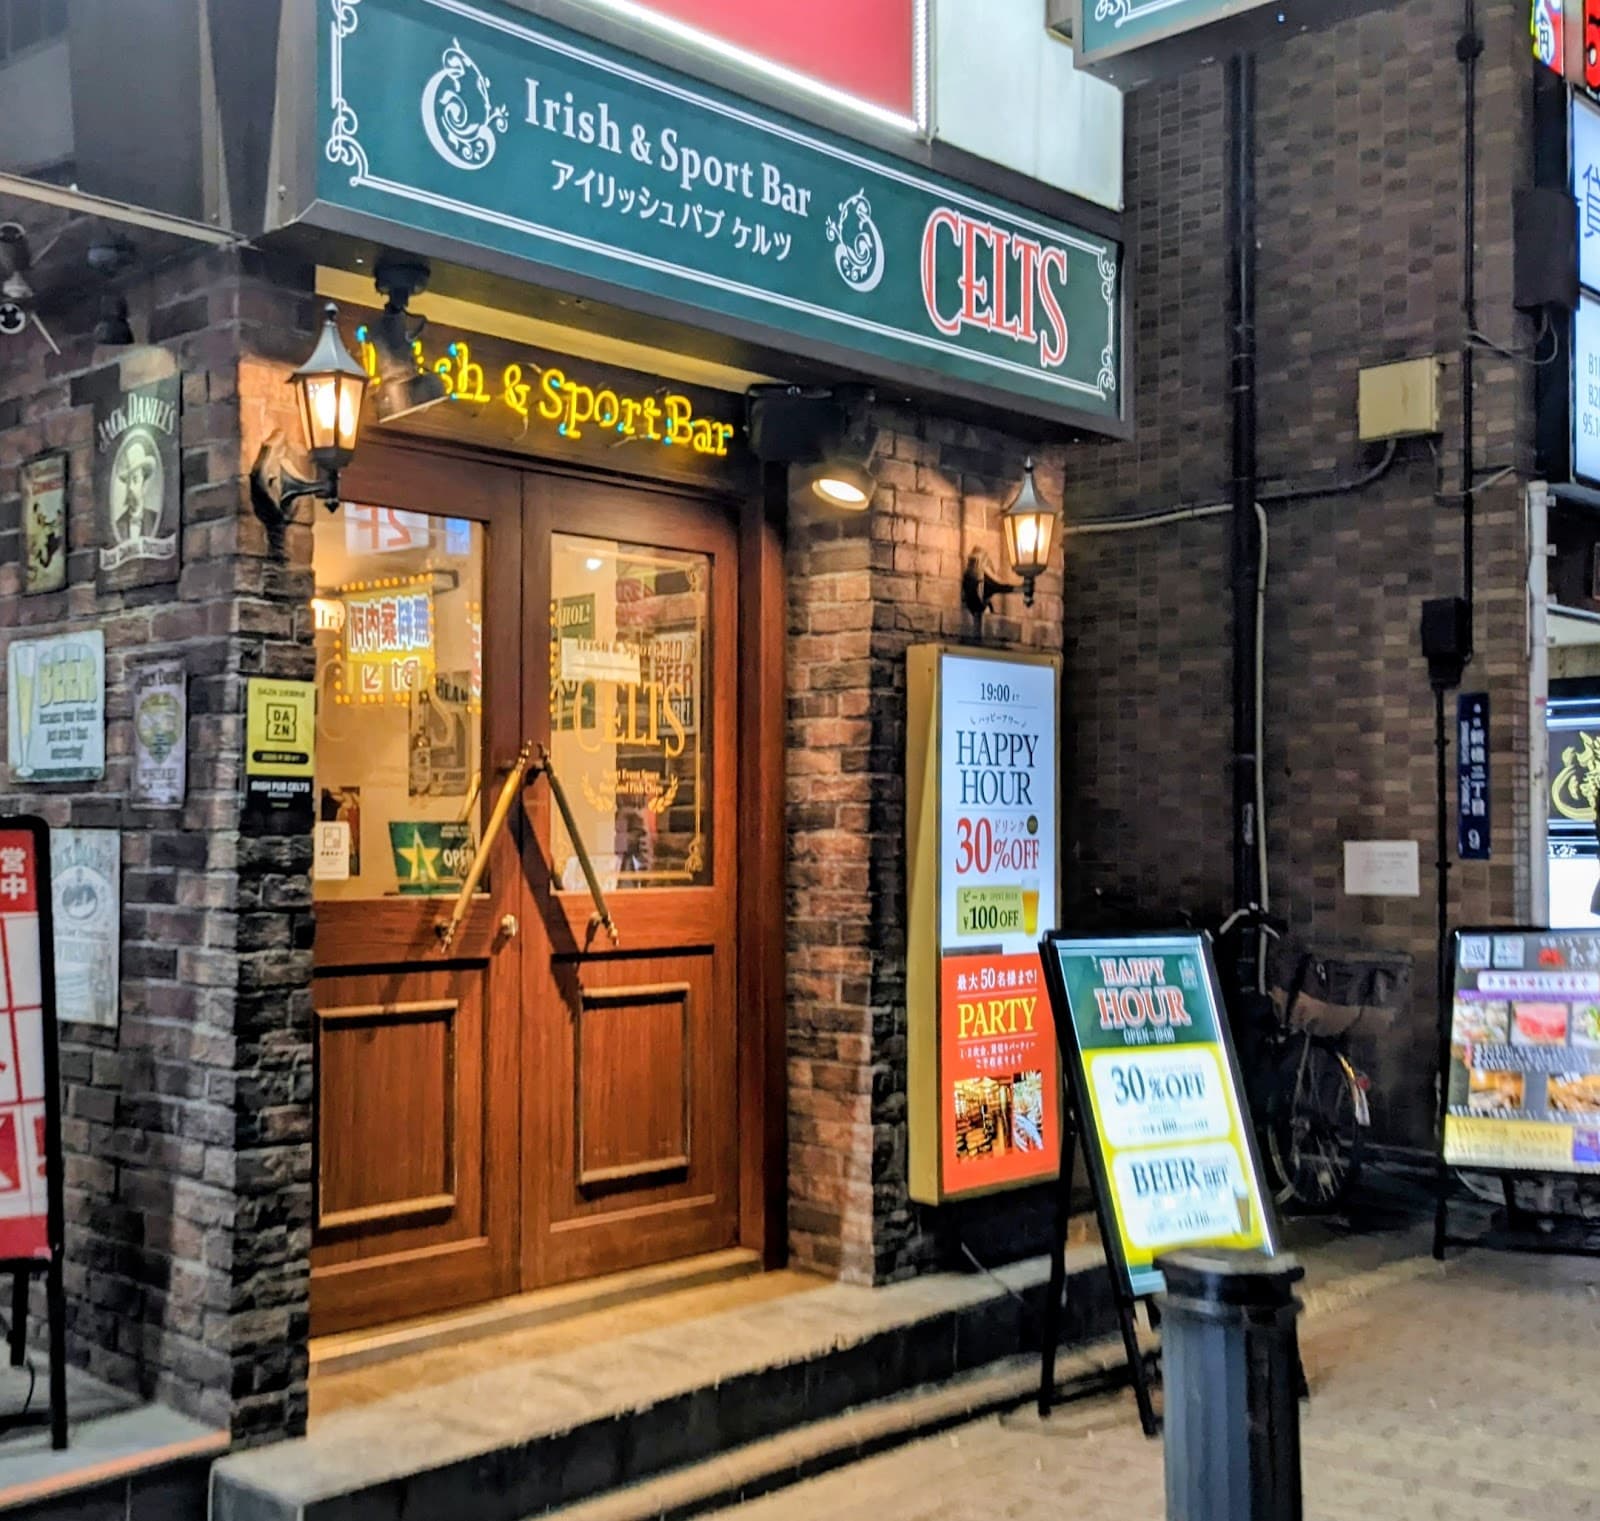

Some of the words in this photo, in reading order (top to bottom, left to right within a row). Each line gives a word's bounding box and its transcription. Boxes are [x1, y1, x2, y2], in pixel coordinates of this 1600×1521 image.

[525, 78, 621, 154] Irish
[631, 124, 653, 166] &
[661, 130, 754, 199] Sport
[762, 163, 811, 218] Bar
[551, 160, 726, 239] アイリッシュパブ
[731, 217, 792, 262] ケルツ
[921, 206, 1068, 369] CELTS
[128, 391, 177, 436] DANIEL'S
[504, 363, 531, 418] &
[539, 368, 661, 441] Sport
[664, 395, 734, 456] Bar
[980, 681, 1010, 702] 19:00
[956, 730, 1039, 768] HAPPY
[960, 769, 1033, 805] HOUR
[999, 909, 1019, 929] OFF
[1100, 957, 1166, 987] HAPPY
[957, 997, 1038, 1039] PARTY
[1093, 986, 1193, 1030] HOUR
[1130, 1157, 1202, 1197] BEER
